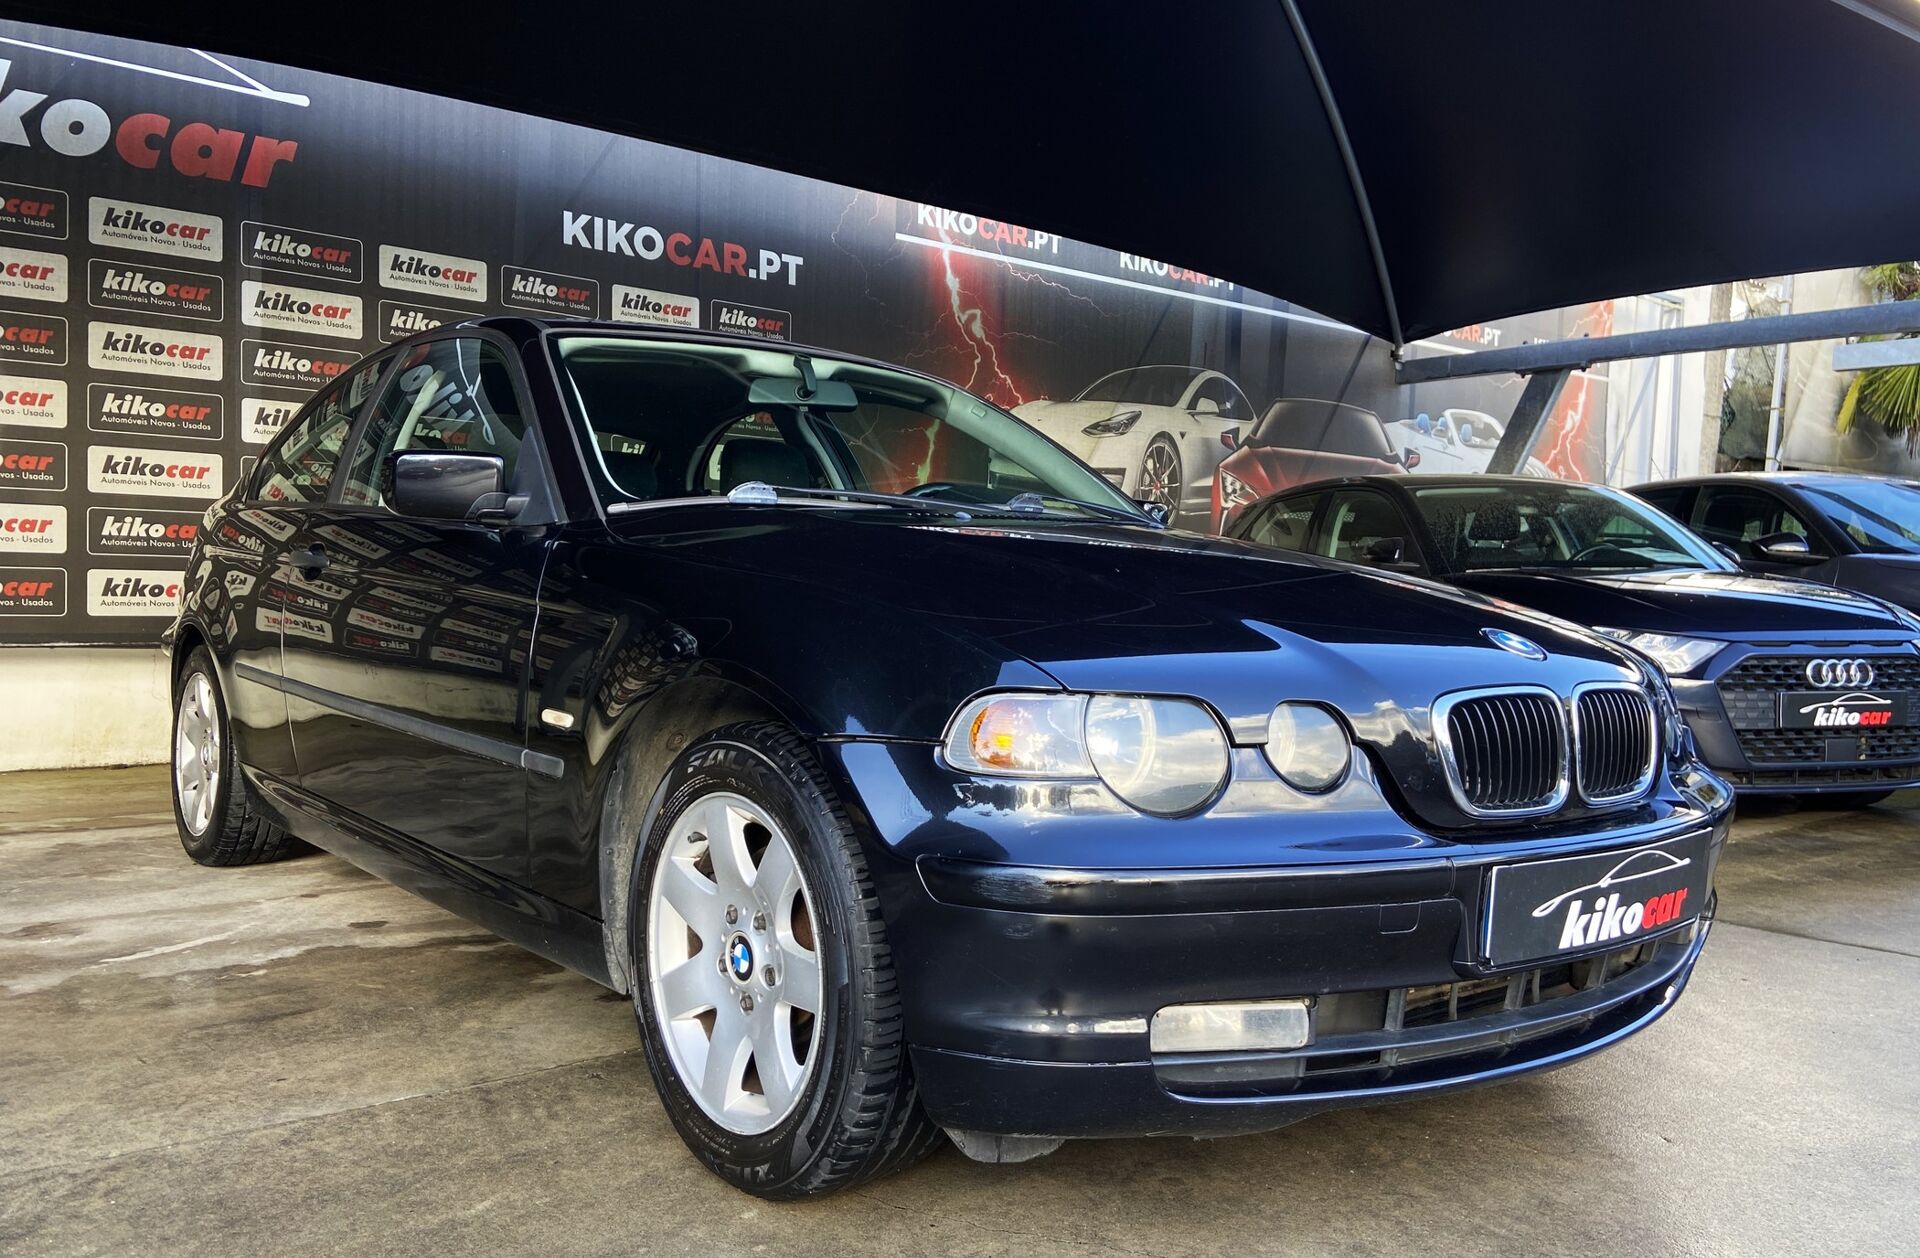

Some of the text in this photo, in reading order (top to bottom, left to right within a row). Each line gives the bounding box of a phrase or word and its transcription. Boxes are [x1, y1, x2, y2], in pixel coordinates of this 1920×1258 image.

[23, 217, 55, 229] Usados
[102, 207, 211, 241] kikocar
[917, 202, 1062, 254] KIKOCAR.PT
[101, 229, 148, 242] Automóveis
[150, 236, 176, 246] Novos
[182, 241, 211, 252] Usados
[254, 231, 352, 263] kikocar
[562, 209, 804, 287] KIKOCAR.PT
[253, 252, 296, 265] Automóveis
[297, 259, 320, 269] Novos
[326, 264, 352, 274] Usados
[390, 254, 478, 284] kikocar
[23, 281, 55, 292] Usados
[102, 269, 212, 301] kikocar
[389, 273, 427, 285] Automóveis
[429, 280, 450, 289] Novos
[454, 283, 478, 293] Usados
[511, 274, 591, 302] kikocar
[101, 291, 148, 304] Automóveis
[150, 297, 176, 307] Novos
[182, 301, 212, 312] Usados
[254, 290, 352, 320] kikocar
[621, 292, 692, 318] kikocar
[253, 311, 296, 322] Automóveis
[298, 316, 321, 326] Novos
[326, 321, 353, 330] Usados
[720, 307, 784, 332] kikocar
[23, 344, 55, 355] Usados
[102, 331, 211, 361] kikocar
[101, 353, 148, 364] Automóveis
[150, 358, 176, 367] Novos
[182, 361, 212, 371] Usados
[253, 369, 296, 380] Automóveis
[297, 374, 321, 383] Novos
[22, 408, 54, 418] Usados
[101, 392, 212, 420] kikocar
[100, 414, 148, 426] Automóveis
[150, 419, 176, 428] Novos
[182, 421, 212, 431] Usados
[22, 472, 54, 481] Usados
[101, 454, 211, 480] kikocar
[100, 476, 148, 486] Automóveis
[149, 480, 175, 488] Novos
[182, 481, 211, 490] Usados
[101, 515, 199, 539] kikoca
[100, 538, 148, 547] Automóveis
[149, 540, 176, 548] Novos
[21, 598, 54, 607] Usados
[1813, 707, 1892, 726] kikocar
[1558, 887, 1688, 949] kikocar
